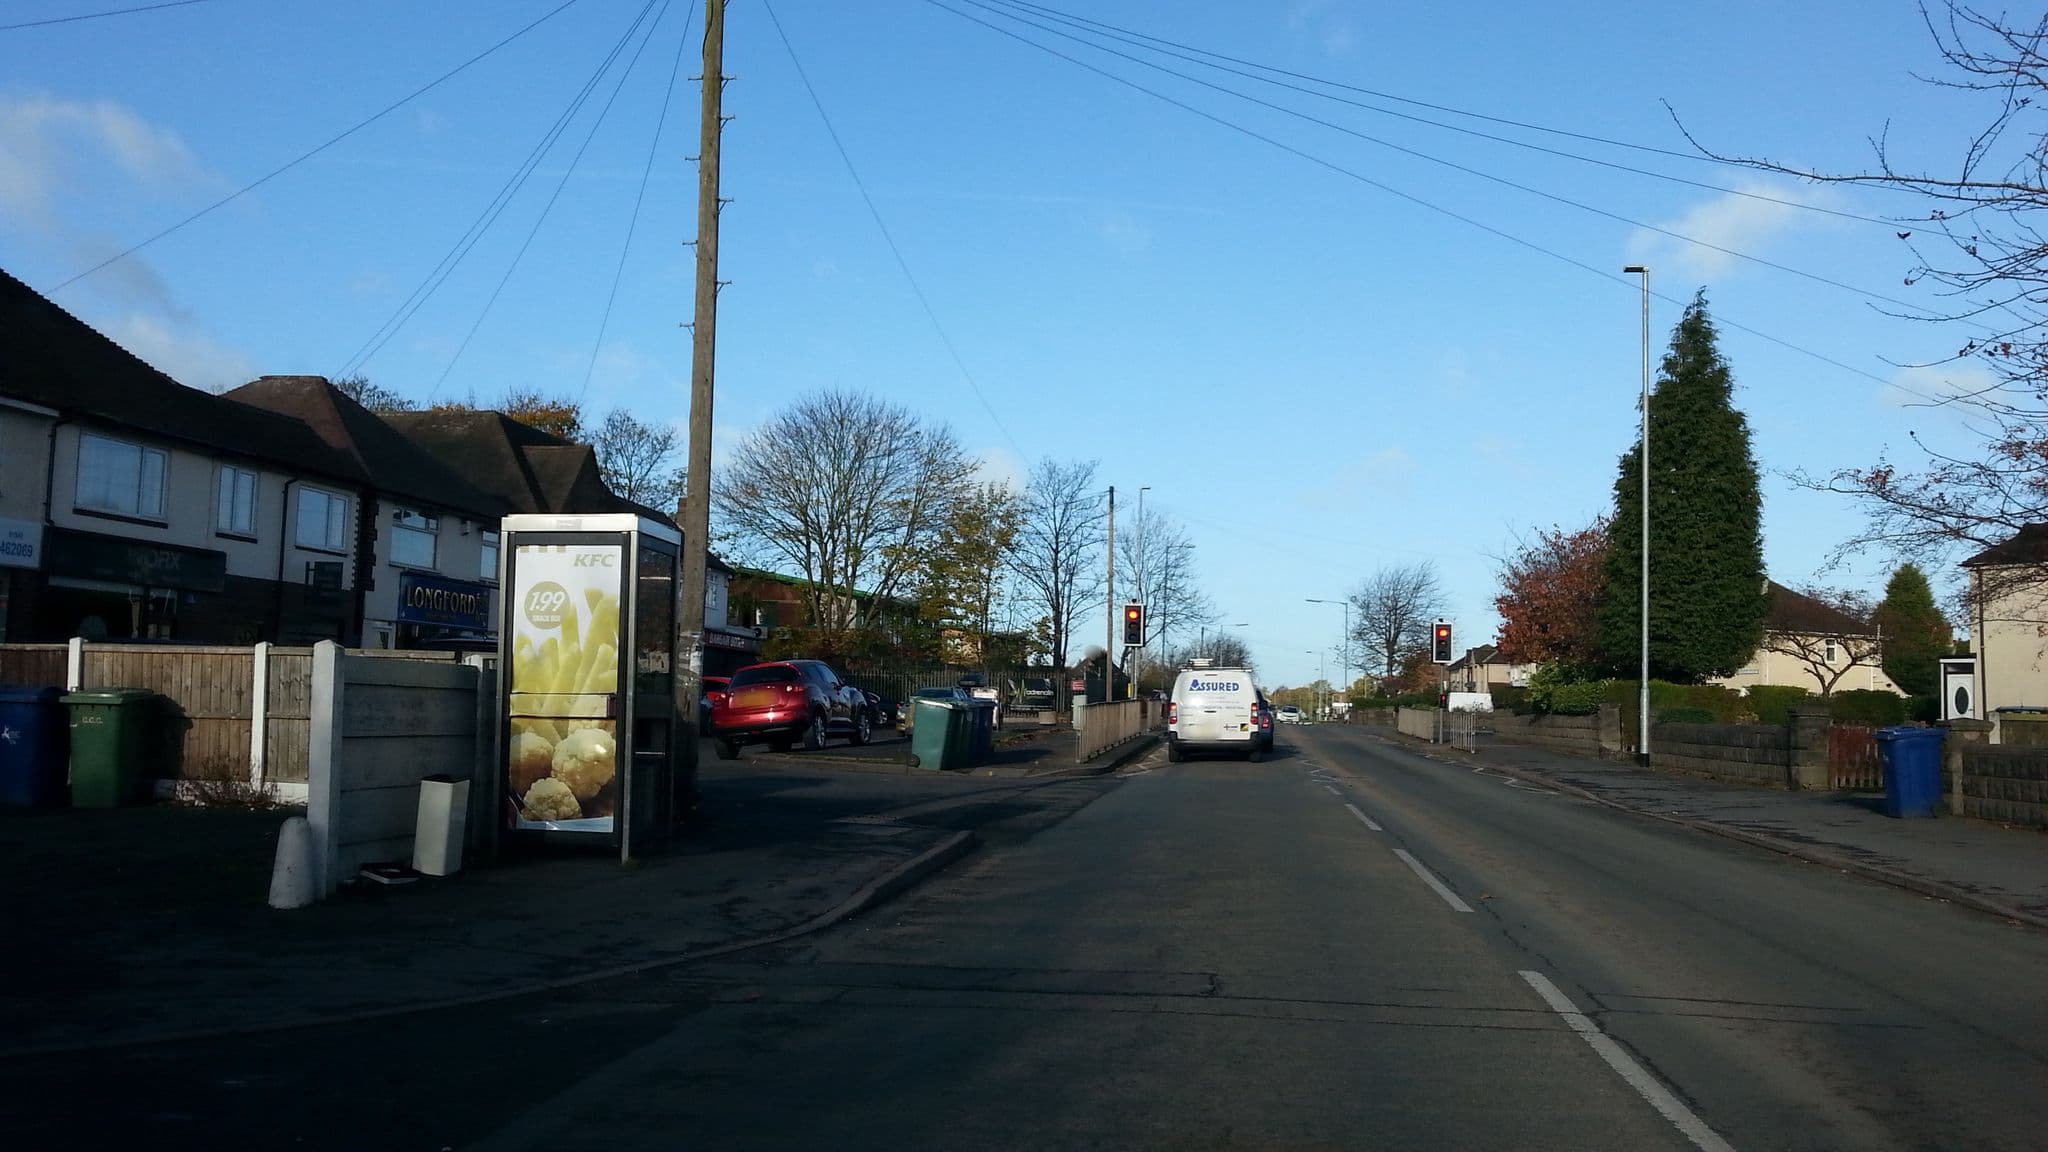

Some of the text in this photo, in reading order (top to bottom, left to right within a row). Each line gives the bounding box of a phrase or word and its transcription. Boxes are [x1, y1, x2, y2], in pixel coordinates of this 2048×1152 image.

[573, 553, 616, 568] KFC
[529, 591, 566, 612] 1.99
[1188, 679, 1240, 692] ASSURED
